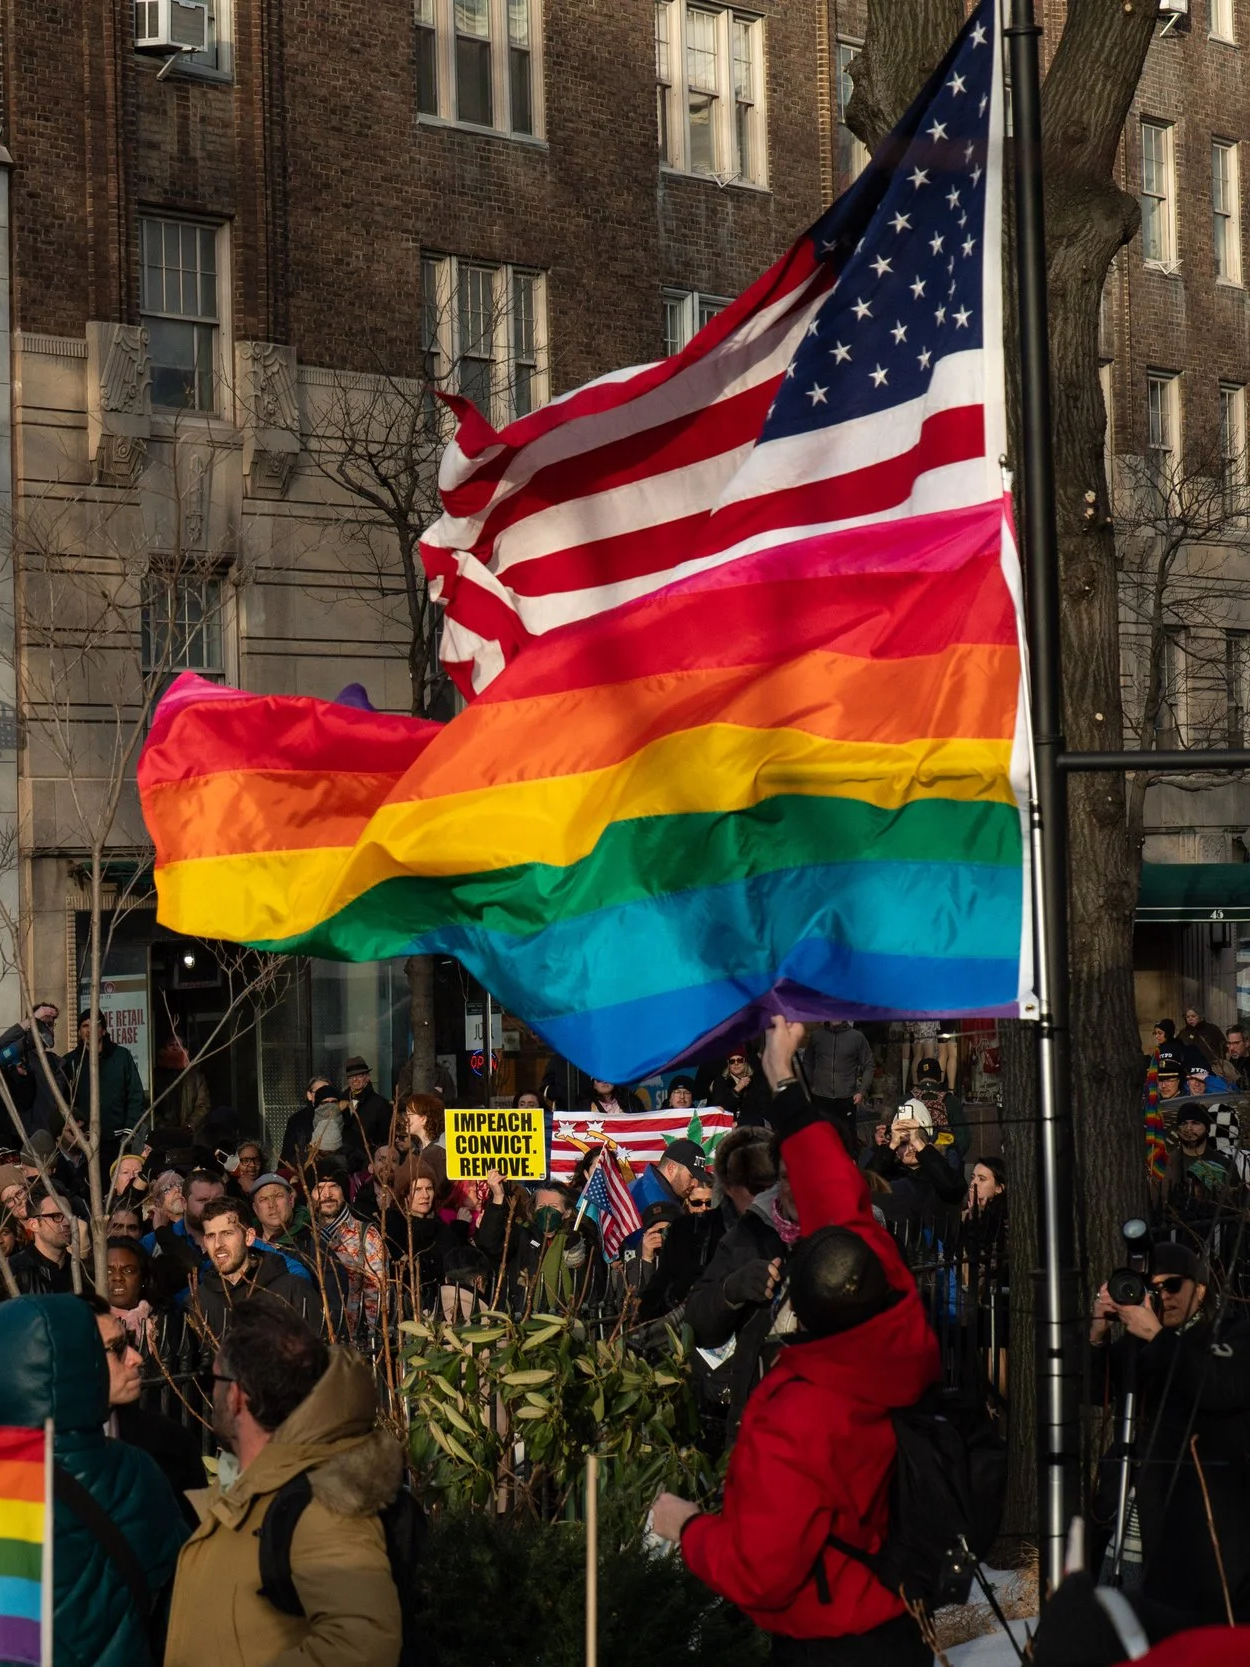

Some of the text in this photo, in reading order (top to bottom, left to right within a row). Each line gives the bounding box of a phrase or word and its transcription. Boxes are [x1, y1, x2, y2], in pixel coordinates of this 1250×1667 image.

[1210, 910, 1224, 919] 45
[116, 1009, 145, 1027] RETAIL
[111, 1027, 138, 1044] LEASE
[470, 1055, 498, 1071] OPN
[453, 1112, 537, 1133] IMPEACH.
[455, 1134, 537, 1155] CONVICT.
[460, 1157, 534, 1177] REMOVE.
